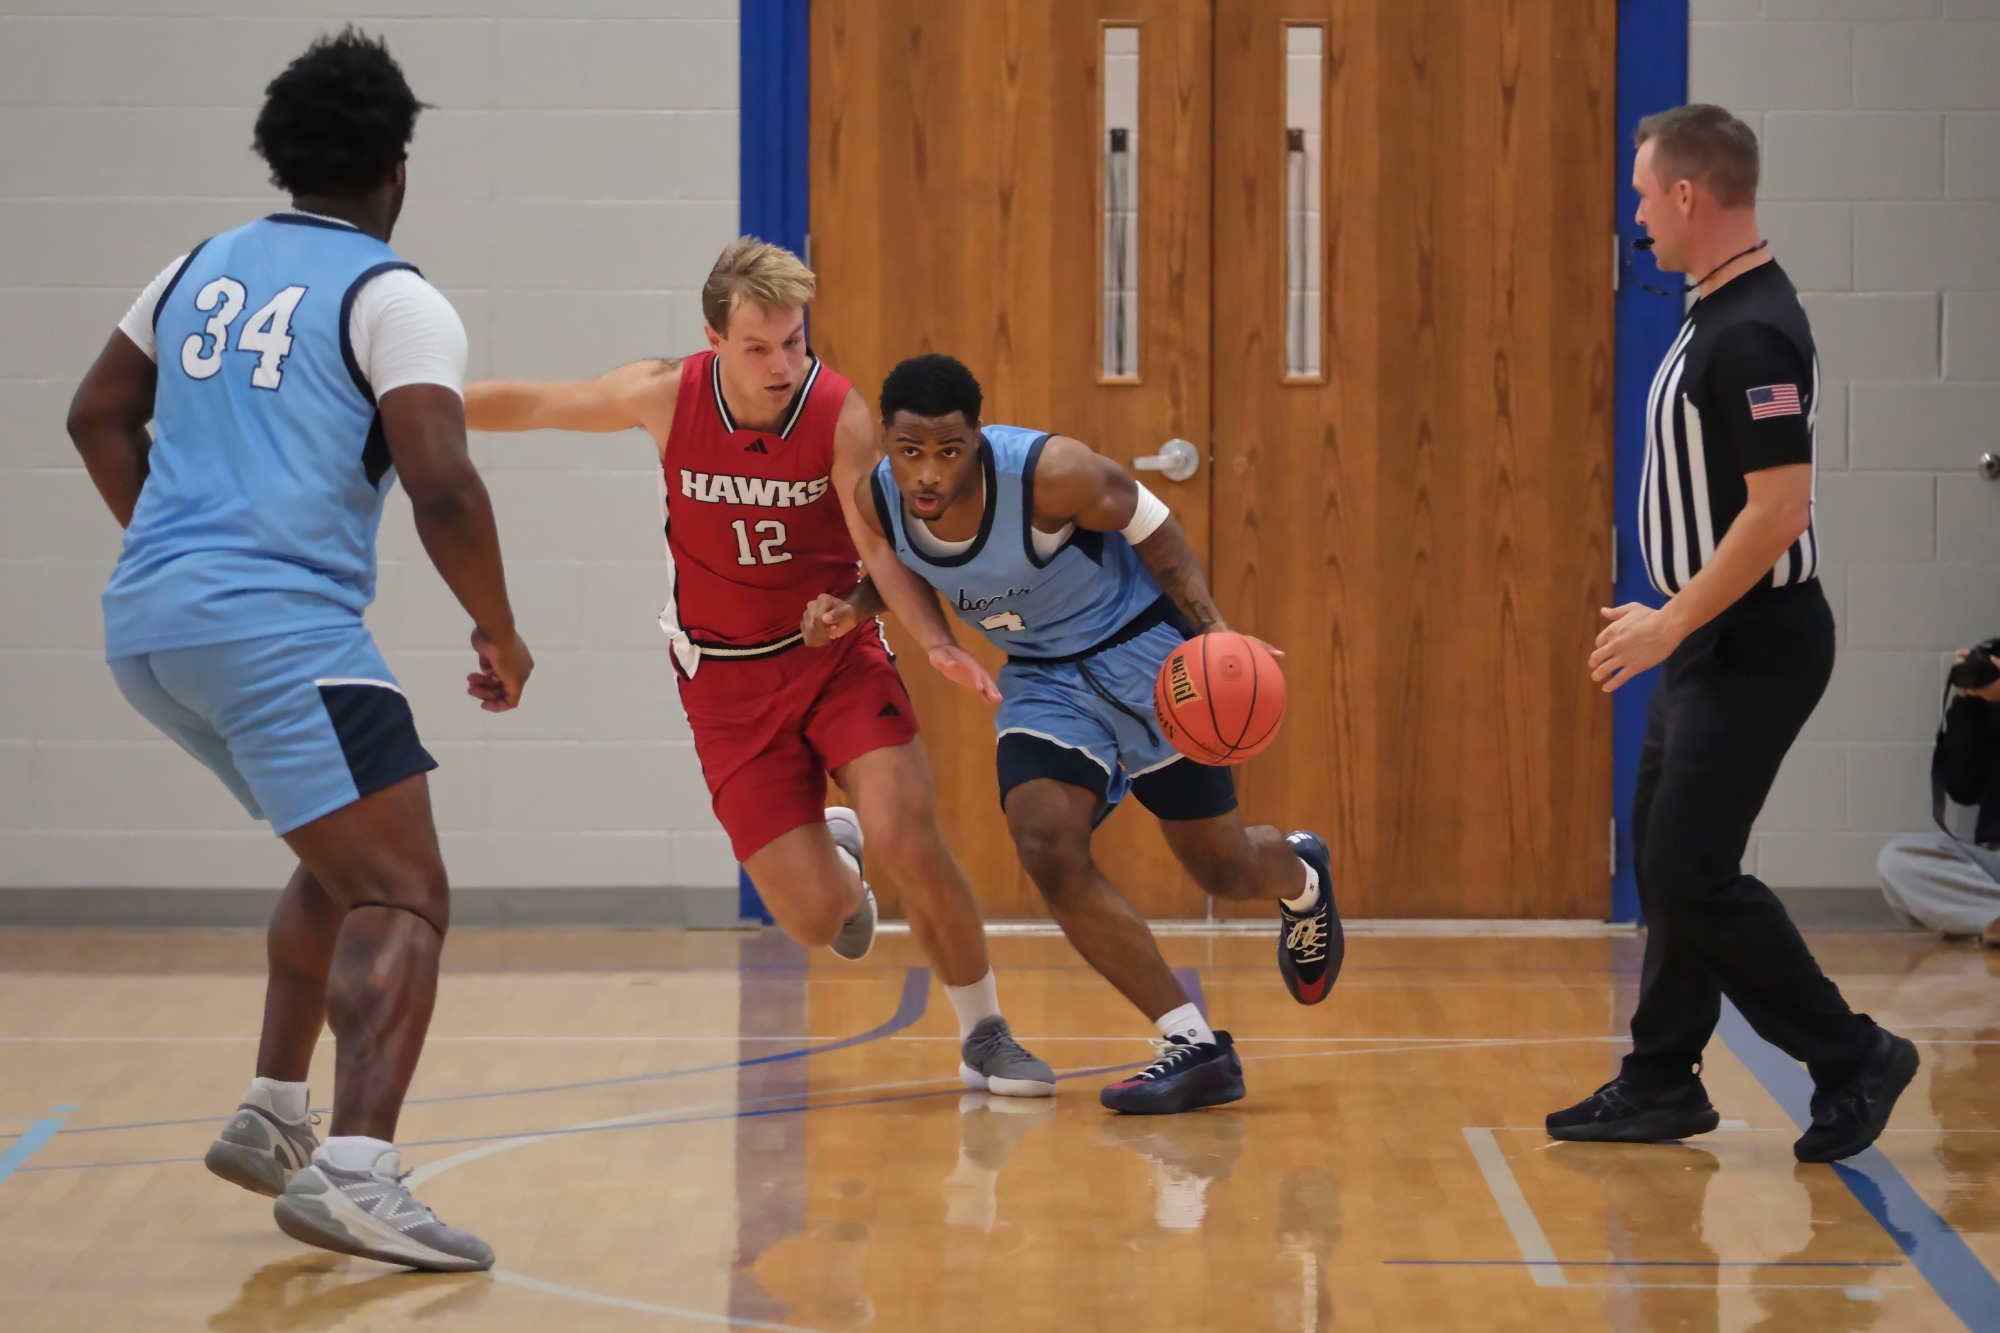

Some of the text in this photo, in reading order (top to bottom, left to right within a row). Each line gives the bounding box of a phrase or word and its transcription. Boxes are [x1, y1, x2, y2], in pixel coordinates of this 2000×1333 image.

[181, 275, 309, 392] 34
[680, 468, 829, 508] HAWKS
[731, 518, 793, 566] 12
[1172, 655, 1198, 704] NJCAA
